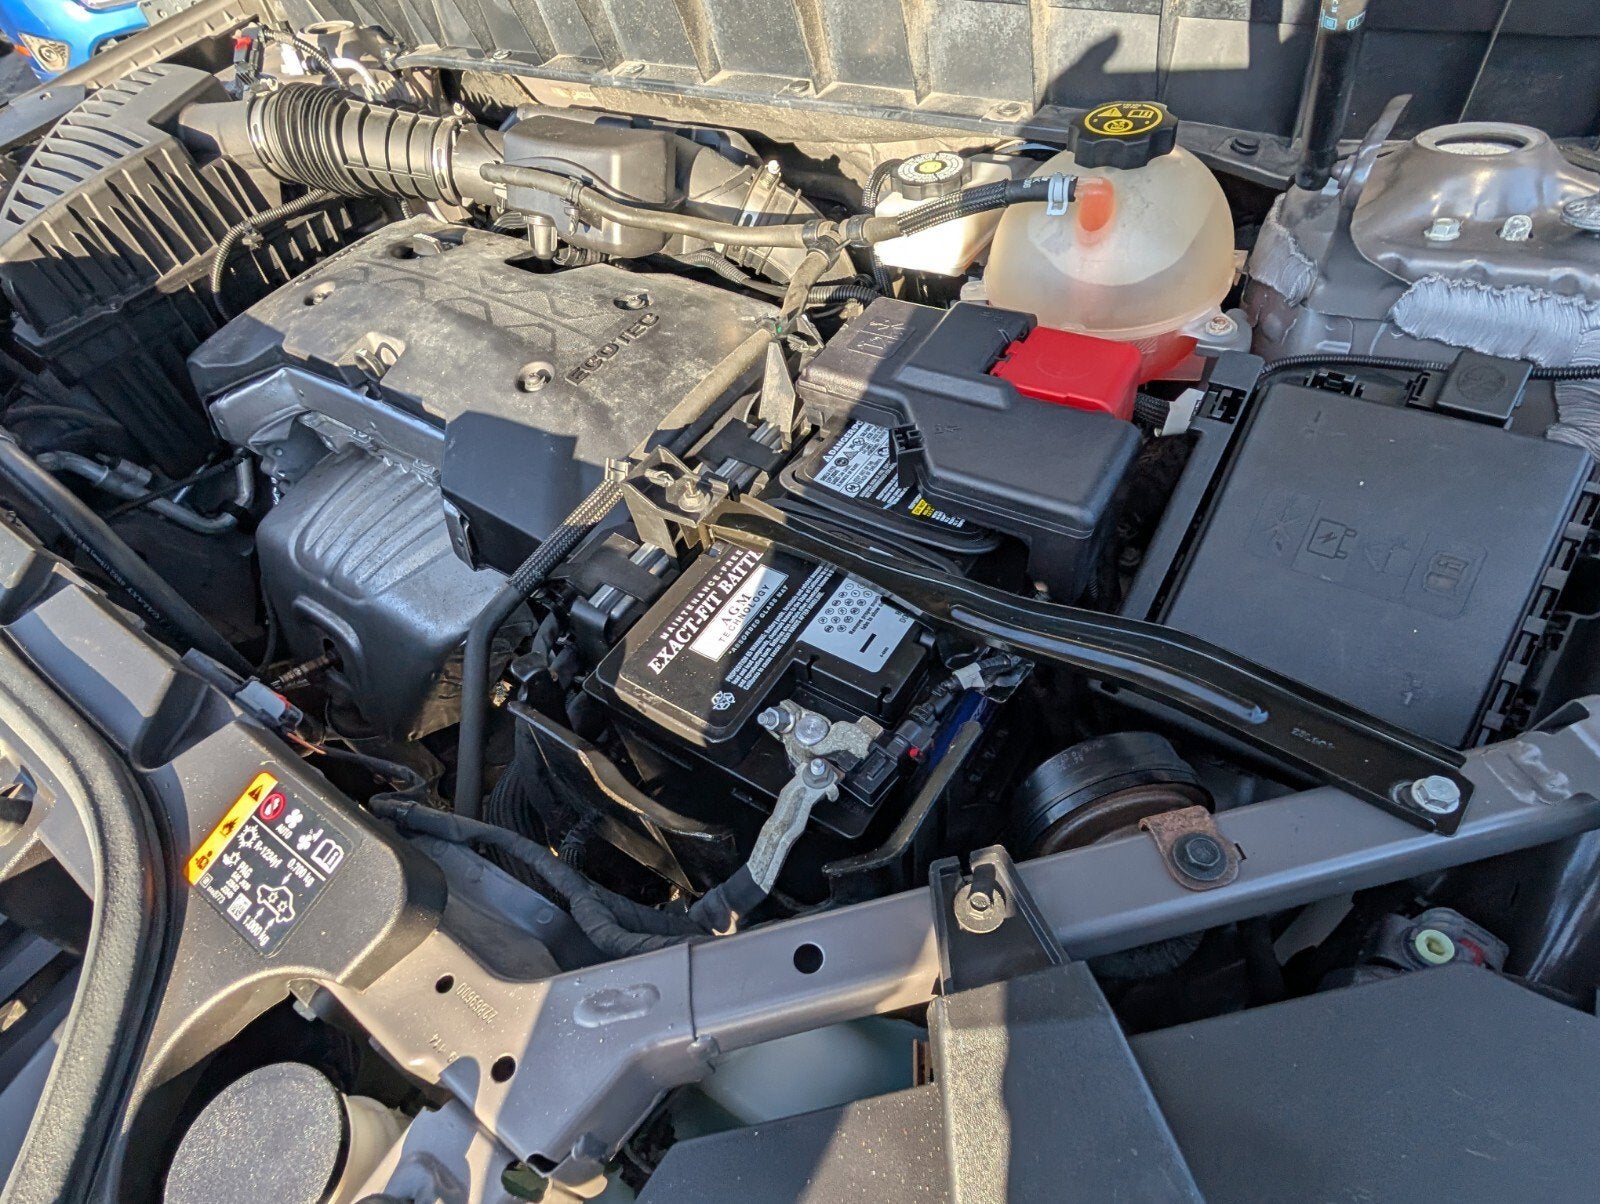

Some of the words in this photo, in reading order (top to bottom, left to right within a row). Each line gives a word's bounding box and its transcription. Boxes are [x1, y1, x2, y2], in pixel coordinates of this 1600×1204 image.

[564, 312, 660, 386] ECOTEC
[660, 548, 744, 642] MAINTENANCE-FREE
[720, 592, 751, 626] AGM
[759, 597, 779, 619] GLASS
[776, 584, 790, 599] MAT
[718, 583, 771, 644] TECHNOLOGY
[647, 590, 724, 675] EXACT-FIT
[275, 822, 293, 840] AUTO
[236, 861, 254, 879] PAG
[254, 840, 283, 868] R-1234yf
[286, 859, 308, 879] 0.700
[302, 874, 316, 888] kg
[242, 915, 264, 936] 1.000
[257, 932, 271, 947] kg
